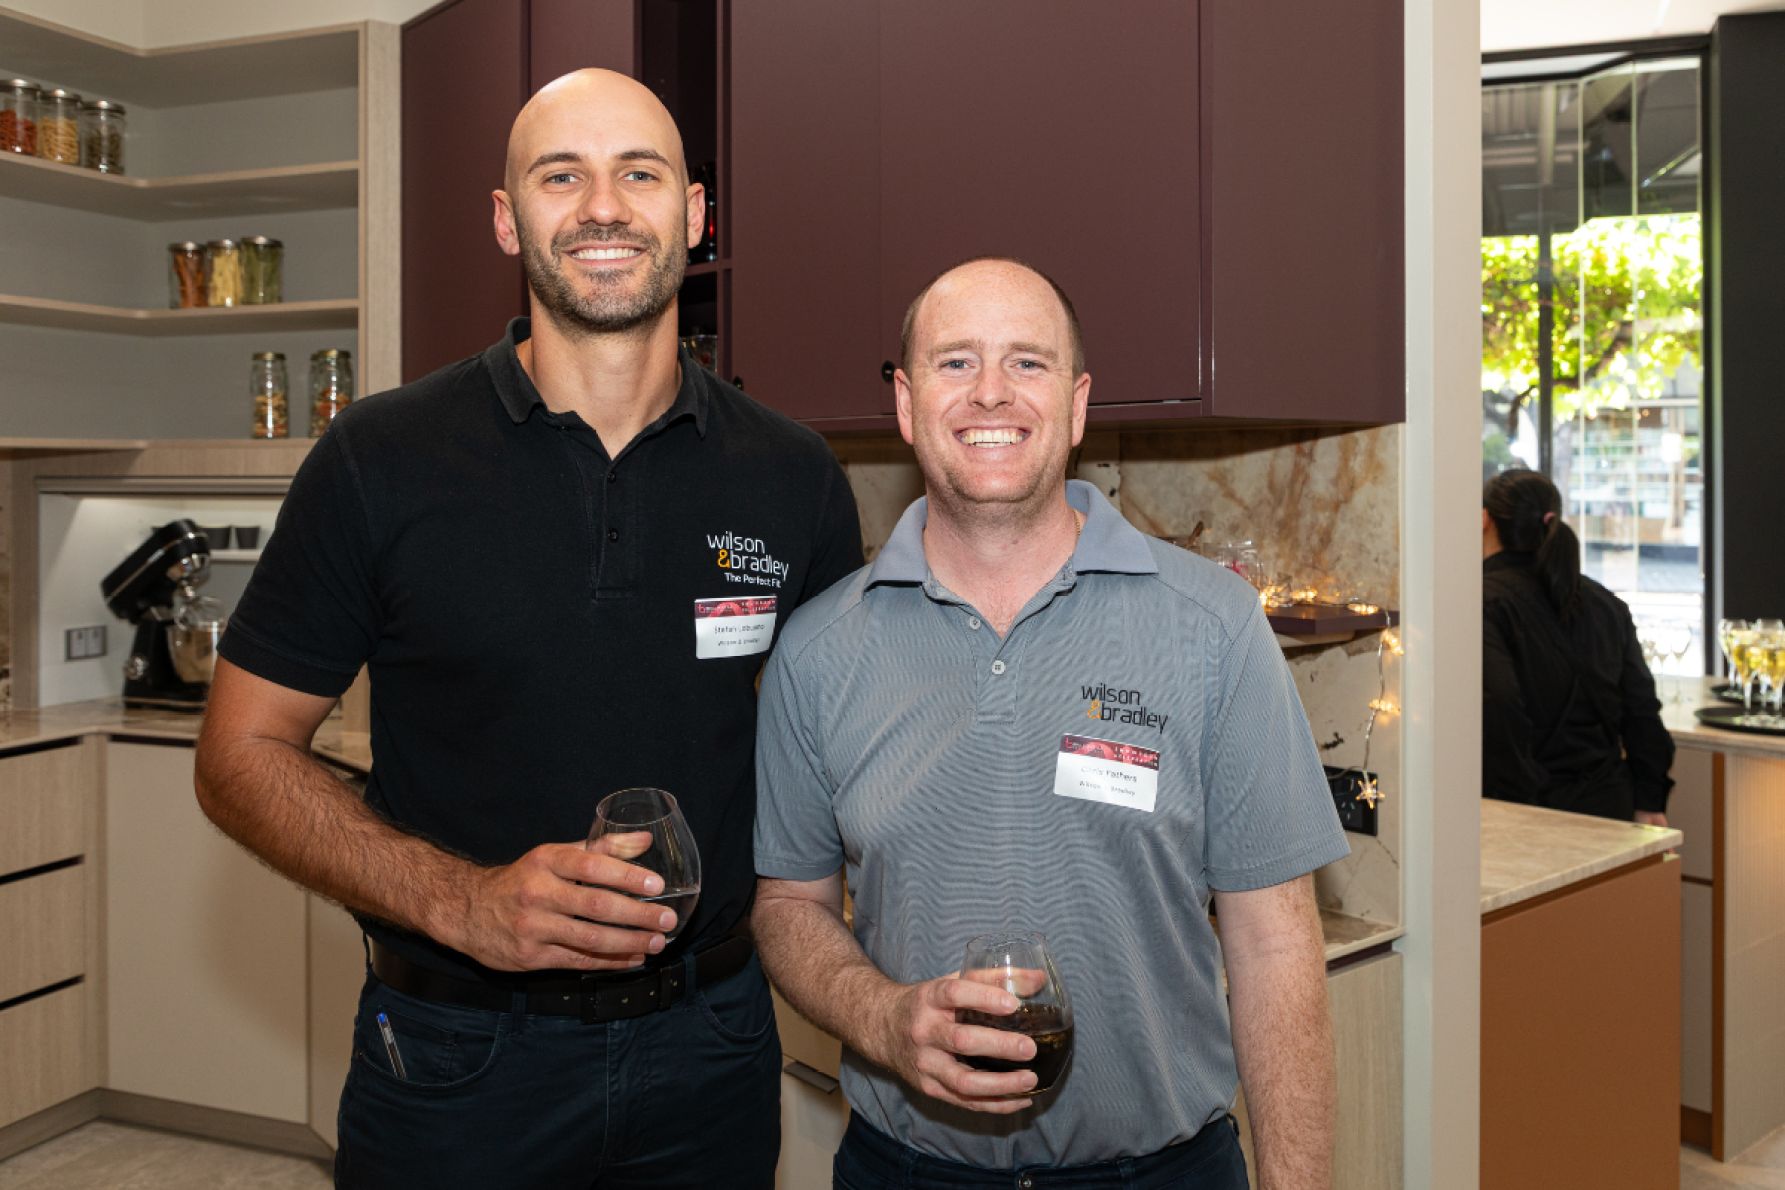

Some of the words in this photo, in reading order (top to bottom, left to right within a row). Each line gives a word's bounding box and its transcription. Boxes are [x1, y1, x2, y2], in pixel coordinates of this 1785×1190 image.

[706, 531, 765, 554] wilson
[724, 572, 742, 583] The
[743, 573, 771, 587] Perfect
[772, 579, 782, 588] Fit
[1081, 682, 1141, 706] wilson
